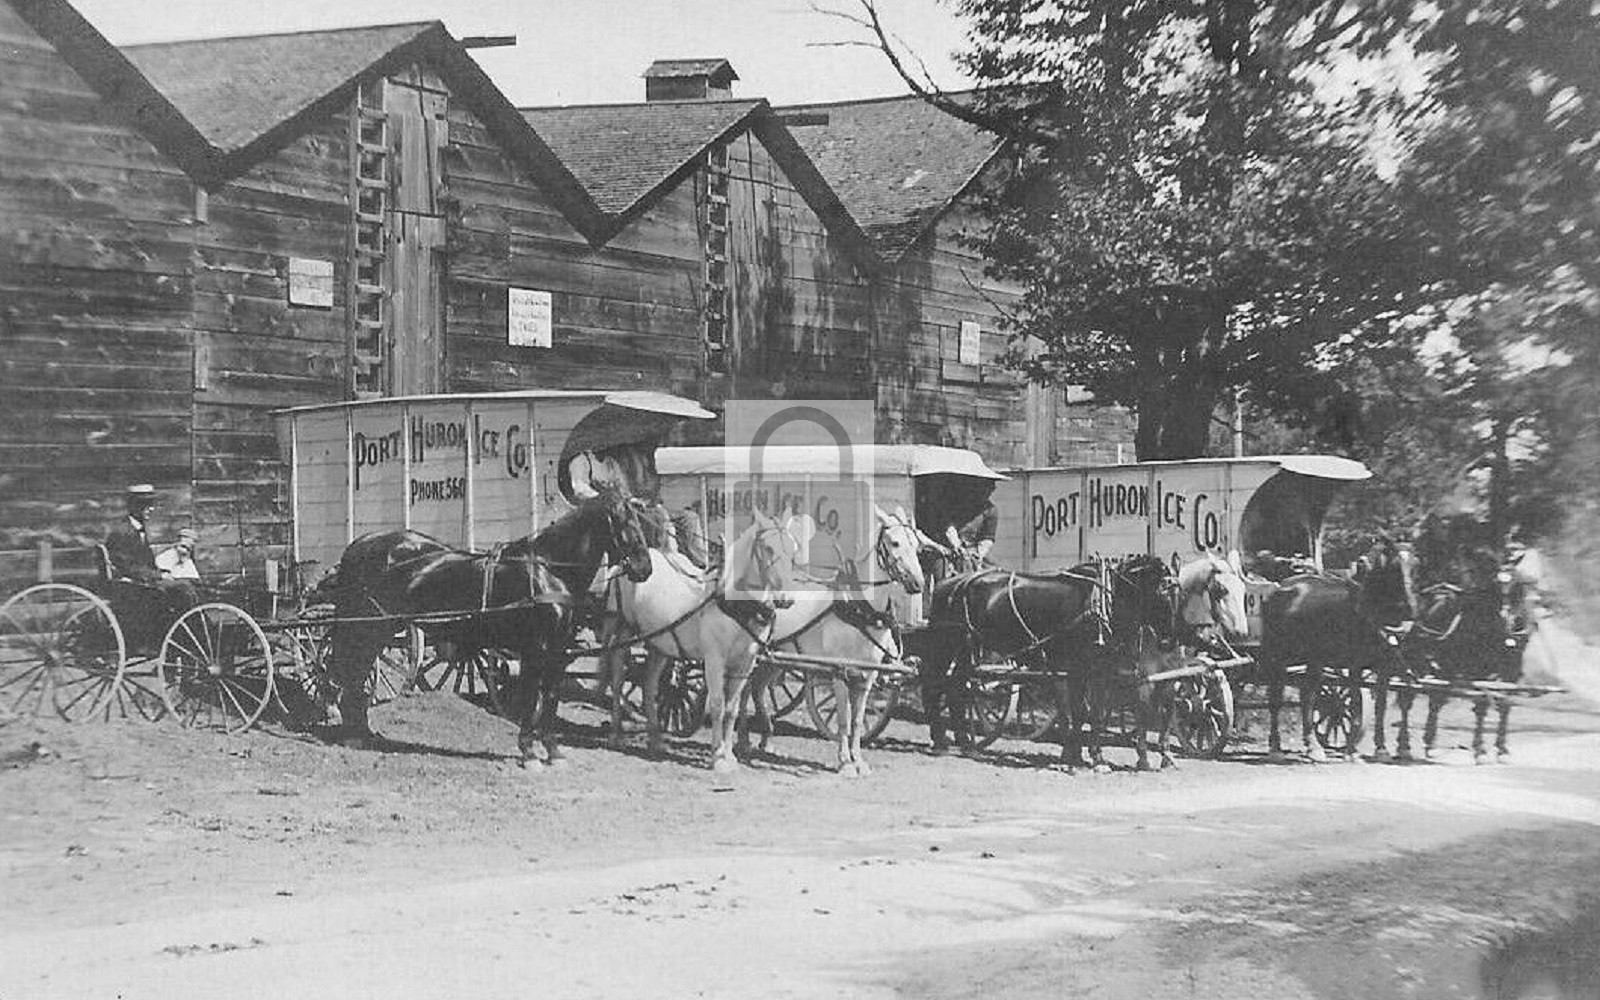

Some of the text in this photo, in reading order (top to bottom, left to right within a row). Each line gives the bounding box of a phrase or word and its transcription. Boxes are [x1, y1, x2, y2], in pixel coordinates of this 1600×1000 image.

[355, 430, 401, 491] PORT
[475, 414, 501, 465] ICE
[411, 478, 445, 506] PHONE
[1031, 491, 1080, 559] PORT
[1089, 477, 1150, 528] HURON
[1156, 480, 1186, 529] ICE
